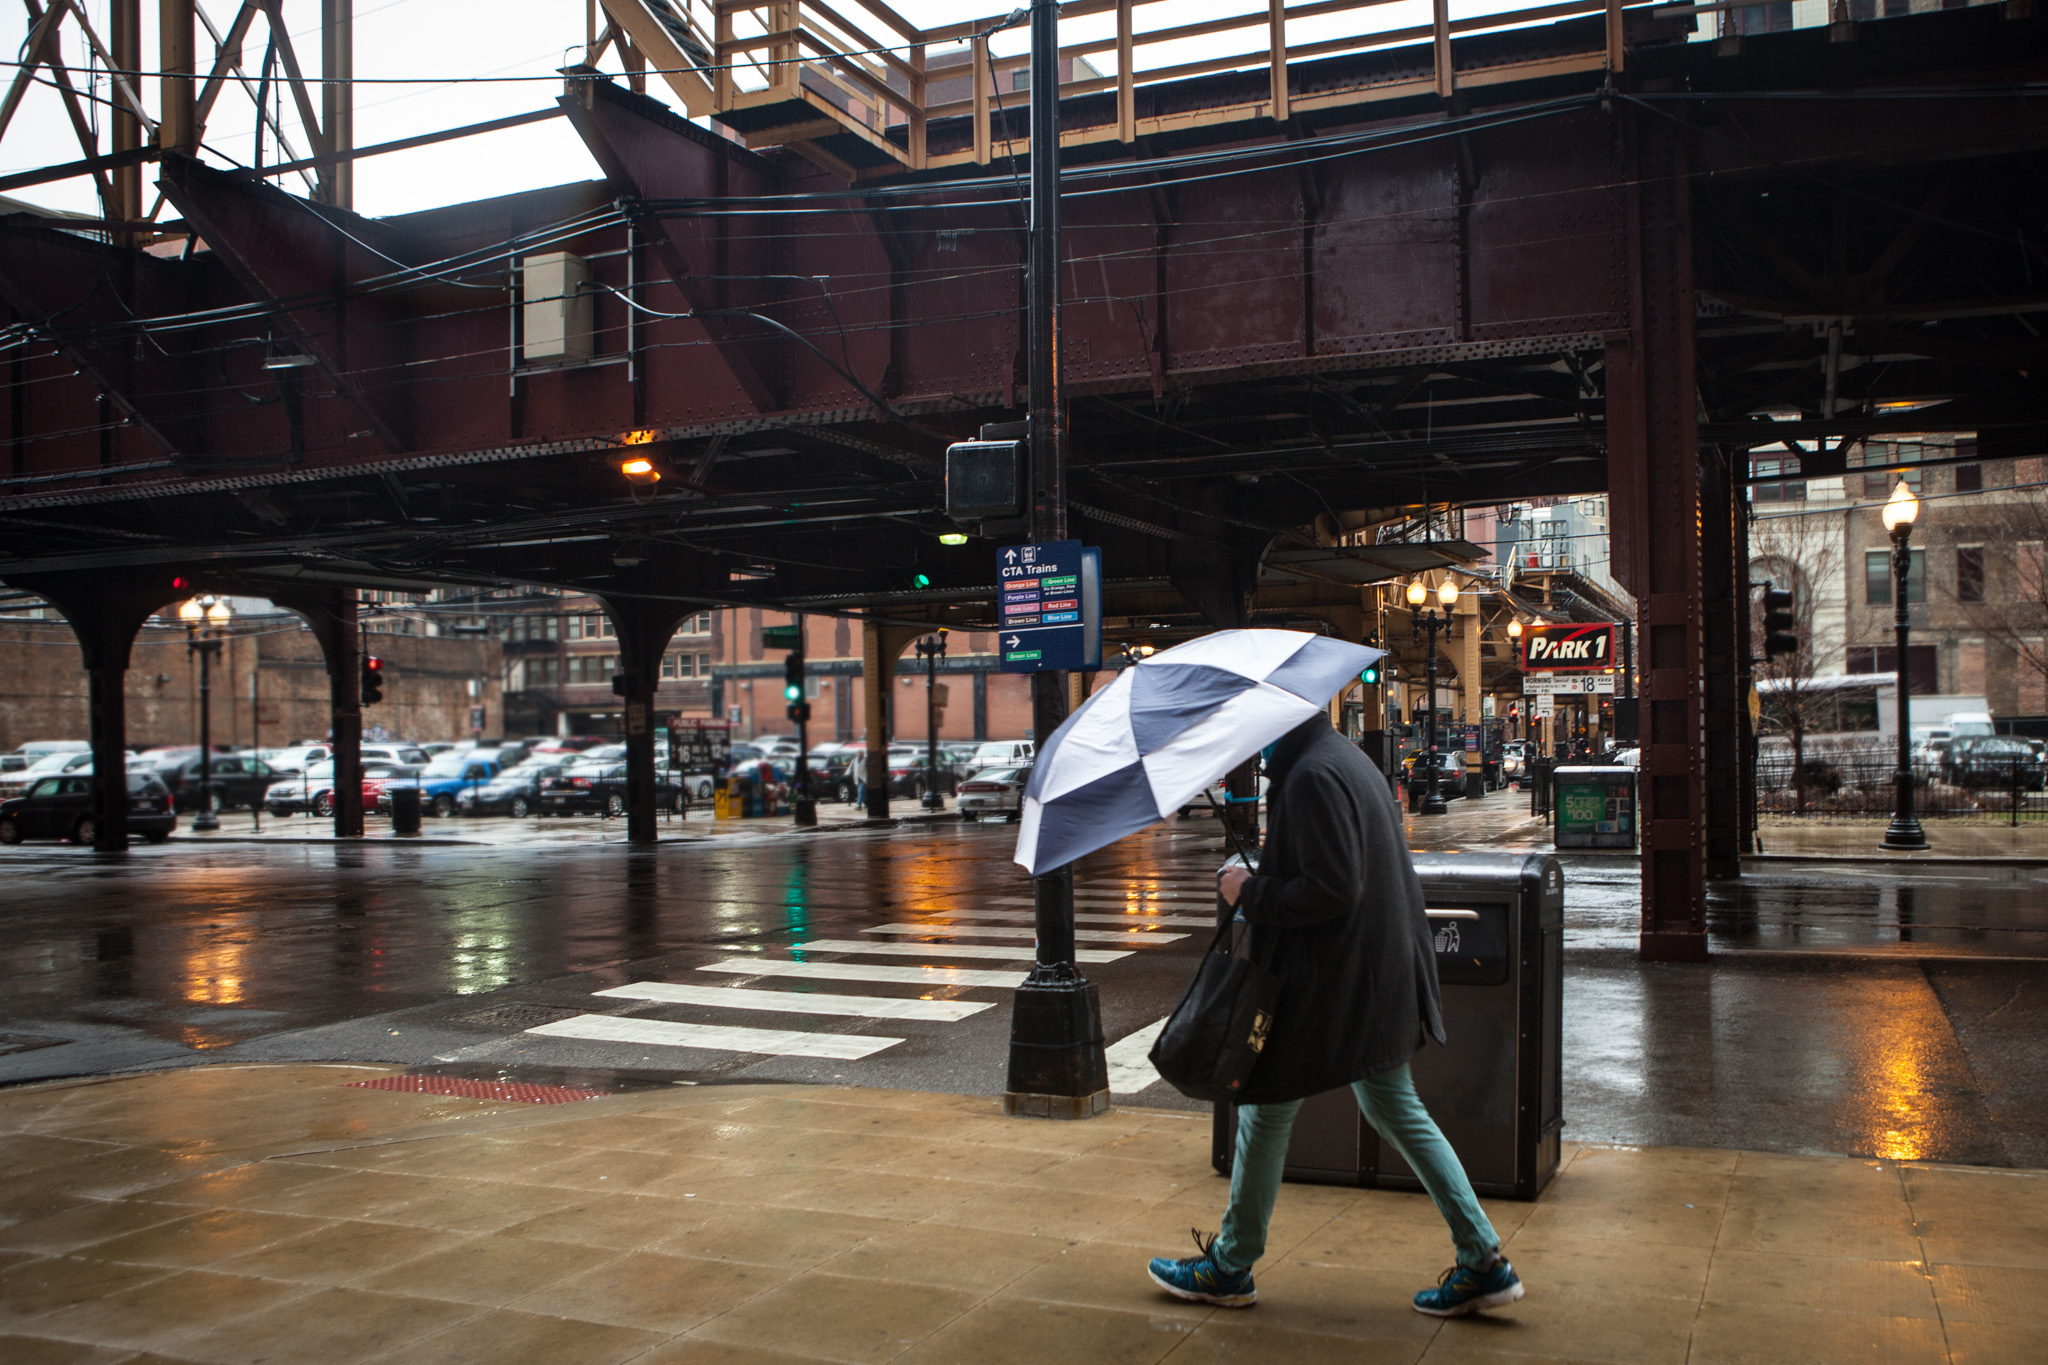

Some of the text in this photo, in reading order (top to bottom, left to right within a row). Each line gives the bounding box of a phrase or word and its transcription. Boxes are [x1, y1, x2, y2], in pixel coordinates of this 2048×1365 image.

[1002, 564, 1058, 577] CTA Trains
[1529, 635, 1607, 660] PARK 1
[1580, 676, 1595, 692] 18
[673, 719, 728, 728] PUBLIC PARKING
[678, 745, 690, 763] 16
[711, 744, 722, 759] 12
[1566, 796, 1600, 808] 5 LINES
